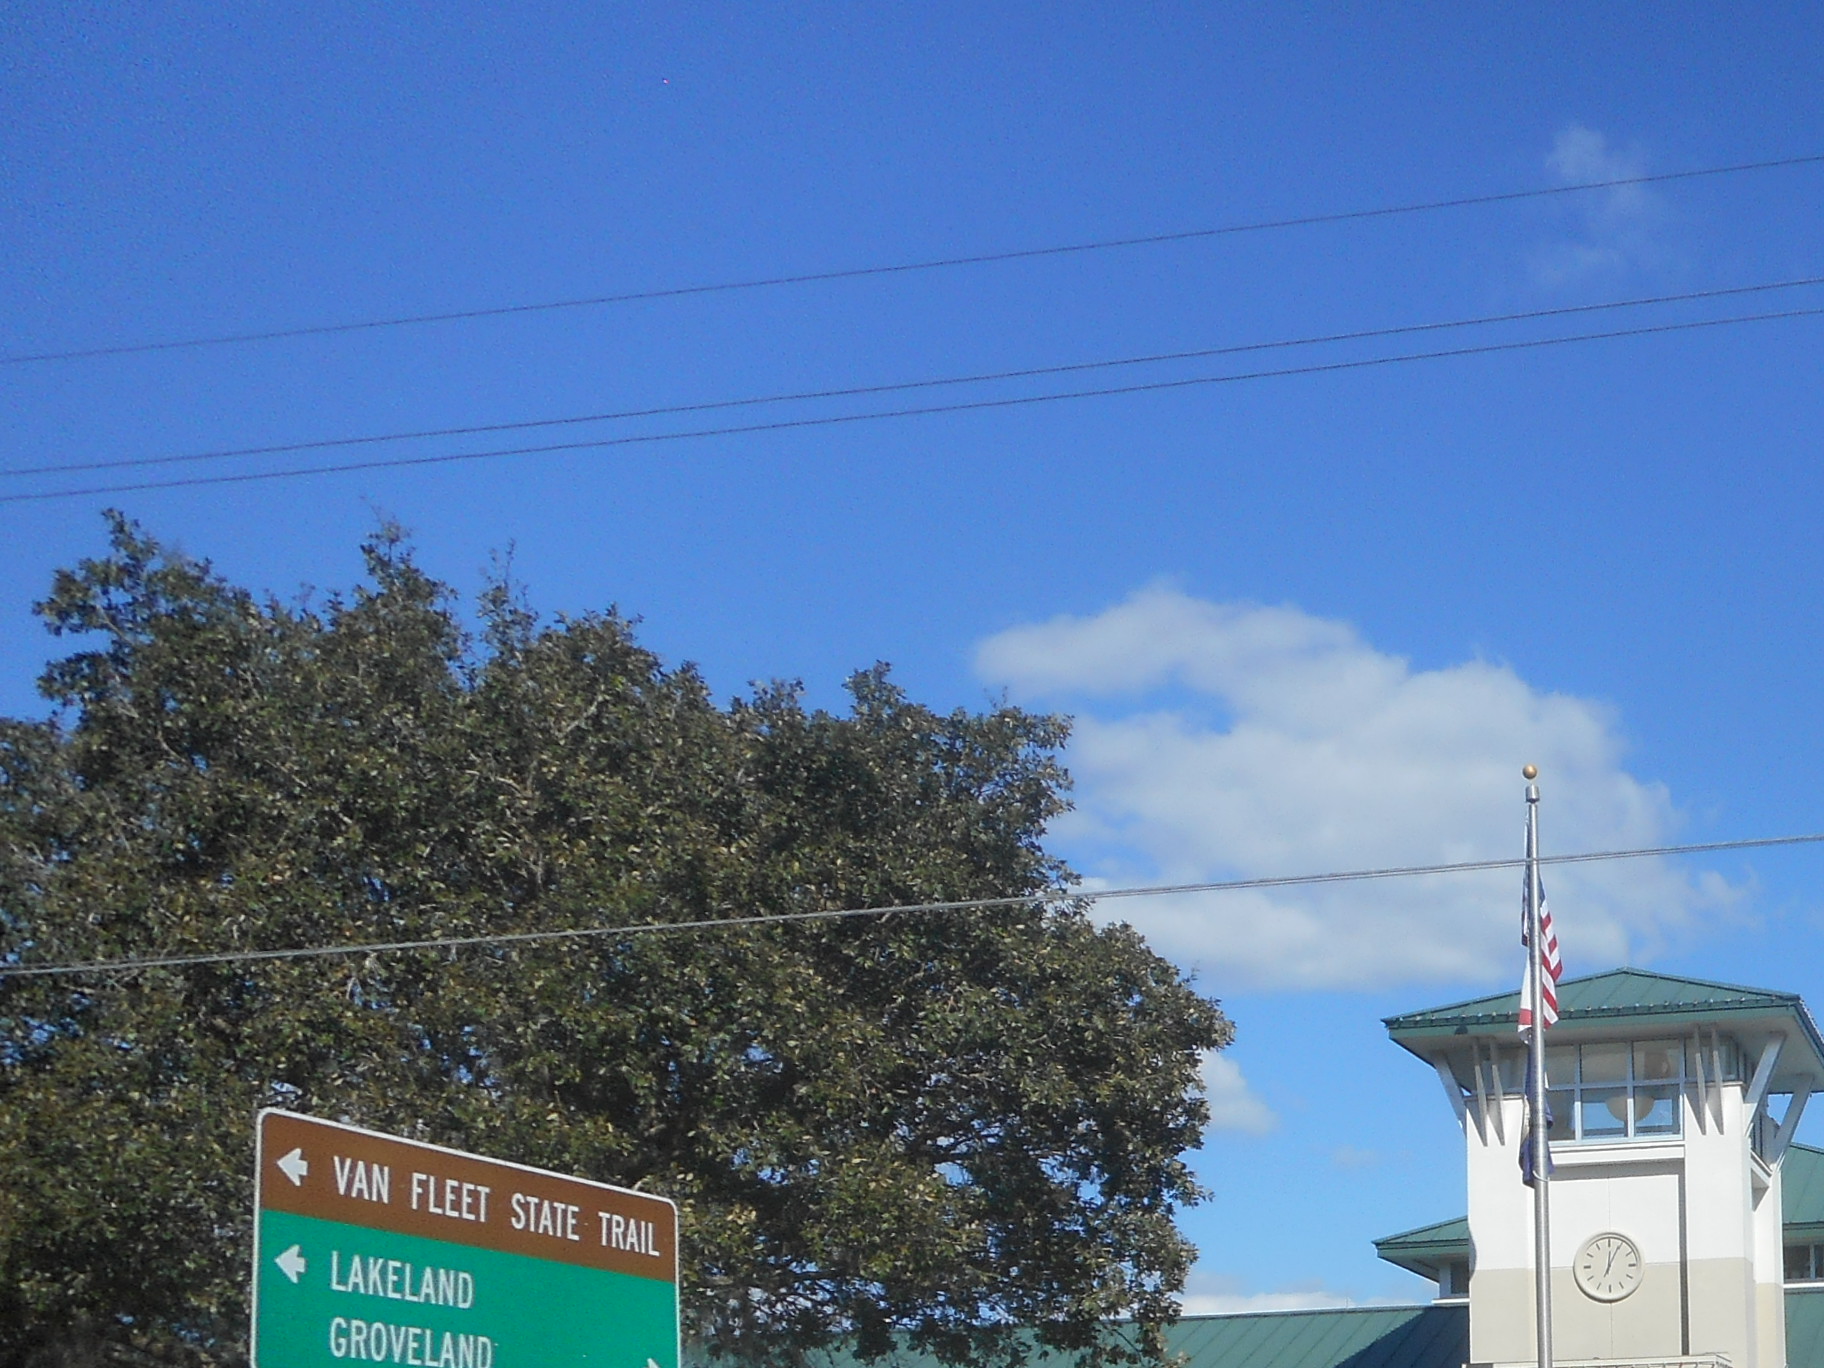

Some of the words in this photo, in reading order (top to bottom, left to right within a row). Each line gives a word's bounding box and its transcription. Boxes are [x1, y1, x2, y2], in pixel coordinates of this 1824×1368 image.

[334, 1156, 389, 1203] VAN
[412, 1173, 490, 1222] FLEET
[511, 1193, 579, 1241] STATE
[598, 1211, 660, 1257] TRAIL
[331, 1250, 473, 1309] LAKELAND
